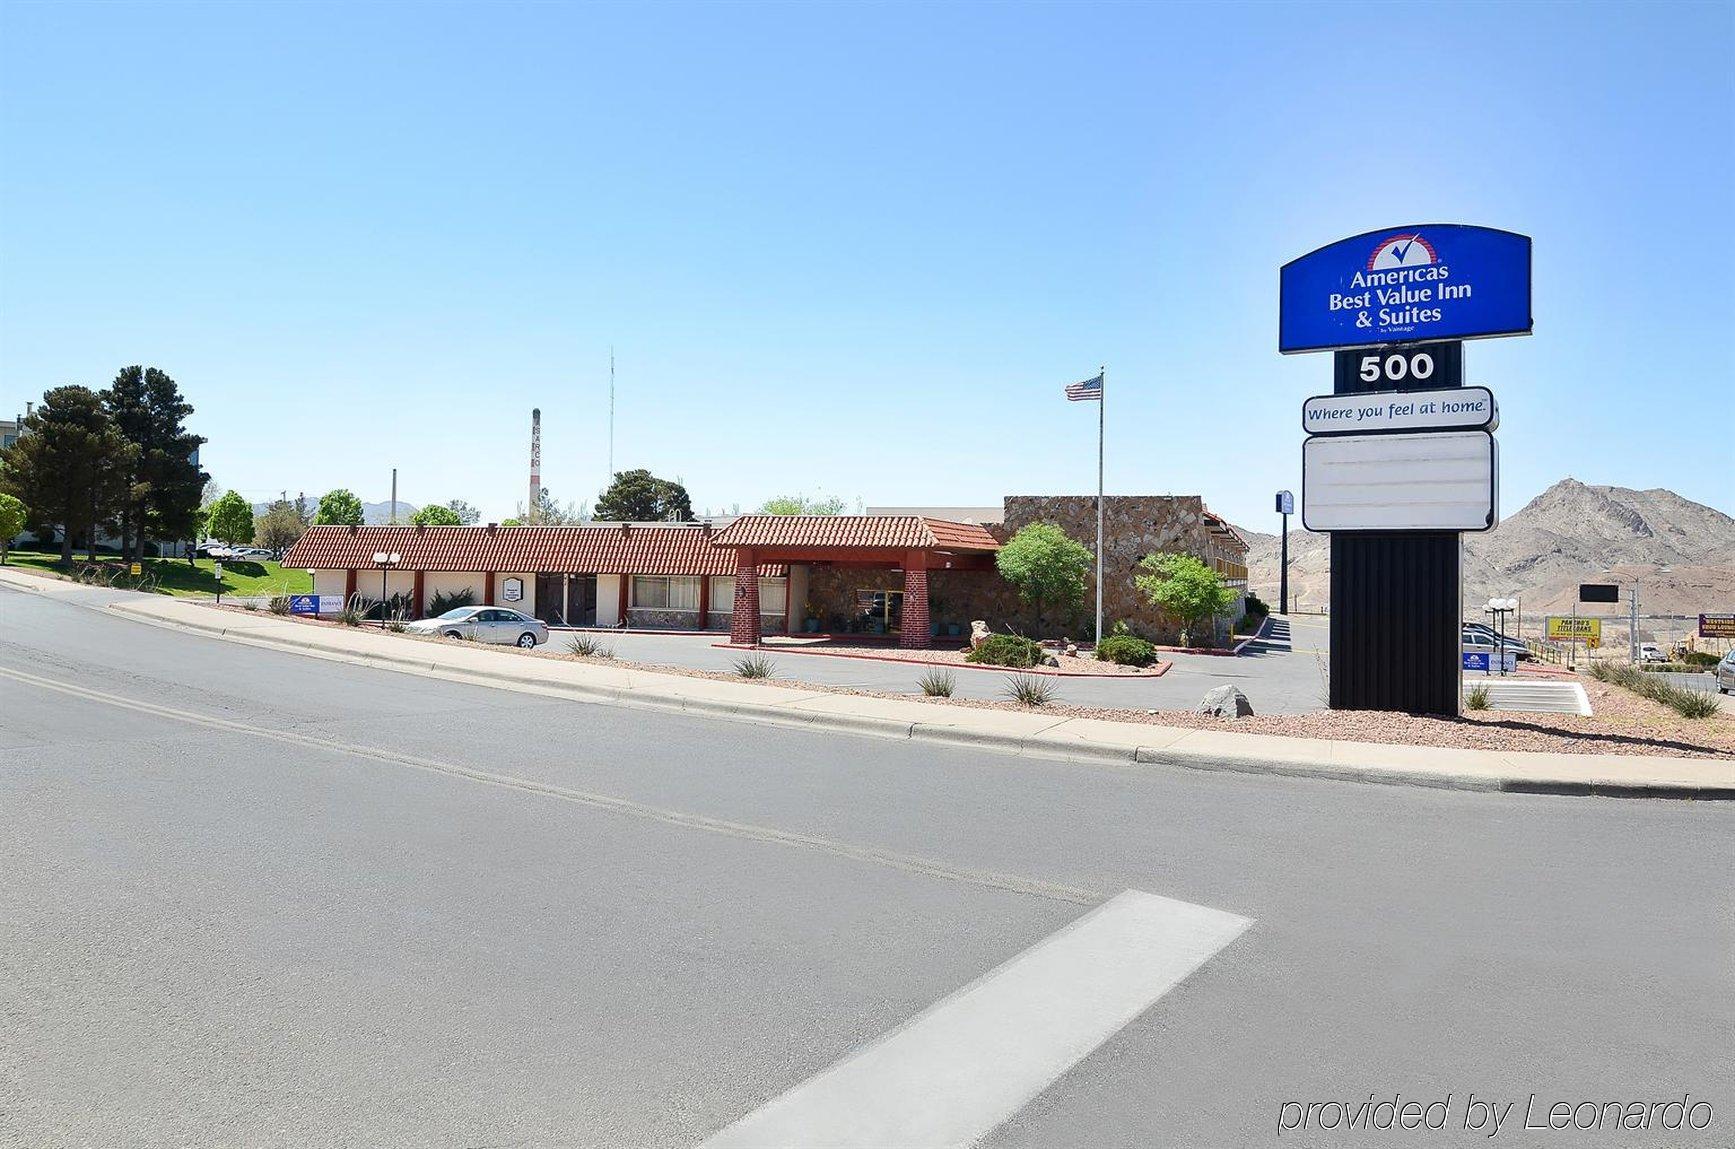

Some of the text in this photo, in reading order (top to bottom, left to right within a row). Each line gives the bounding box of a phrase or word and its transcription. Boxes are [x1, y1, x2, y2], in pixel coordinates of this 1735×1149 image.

[1350, 265, 1449, 289] Americas
[1329, 283, 1472, 311] Best Value Inn
[1355, 305, 1442, 328] & Suites
[1359, 353, 1434, 382] 500
[1308, 408, 1353, 420] Where
[1357, 405, 1383, 421] you
[1388, 403, 1414, 419] feel
[1419, 401, 1436, 414] at
